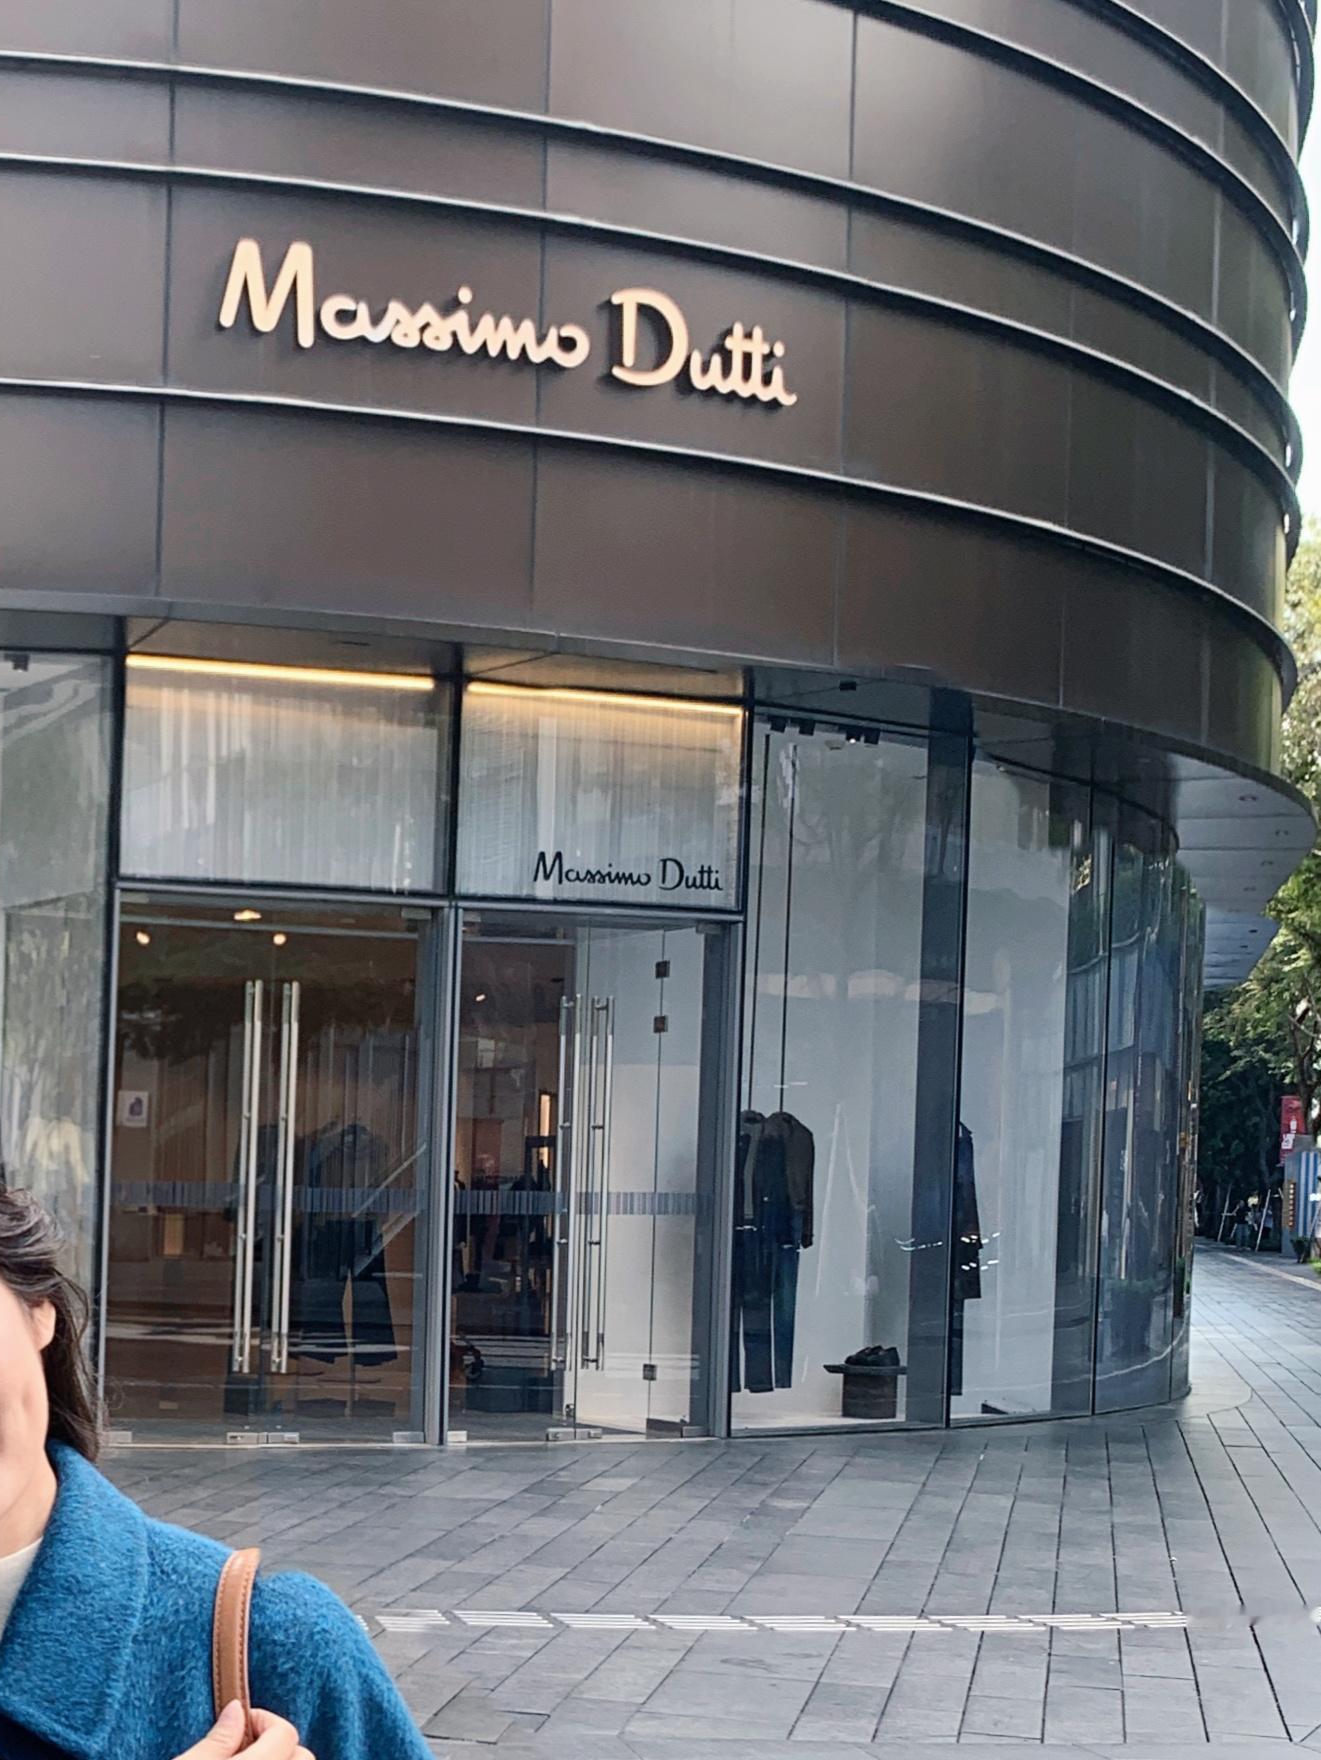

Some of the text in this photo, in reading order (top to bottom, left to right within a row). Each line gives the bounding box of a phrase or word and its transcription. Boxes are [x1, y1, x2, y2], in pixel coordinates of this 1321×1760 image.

[219, 237, 798, 407] Massimo Dutti
[533, 850, 724, 892] Massimo Dutti
